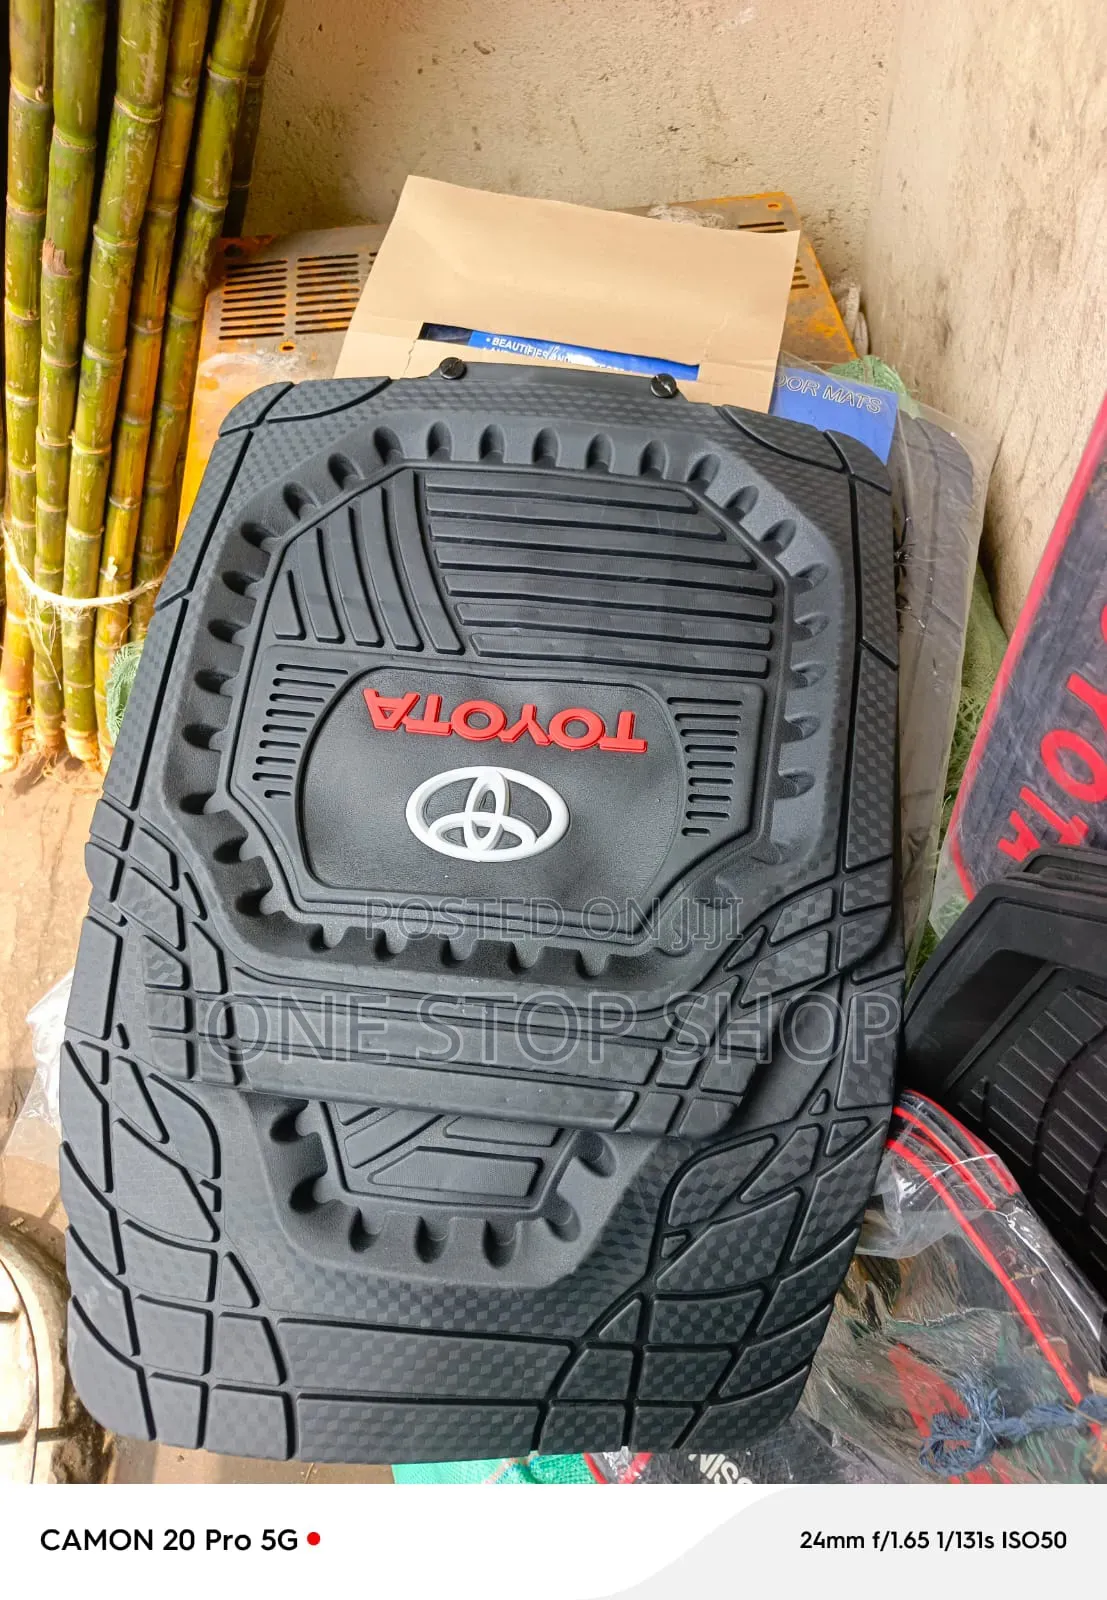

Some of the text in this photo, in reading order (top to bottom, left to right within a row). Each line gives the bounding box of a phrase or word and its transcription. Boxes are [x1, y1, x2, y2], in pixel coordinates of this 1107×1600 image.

[491, 337, 549, 360] BEAUTIFIES
[822, 384, 882, 414] MATS
[363, 688, 648, 753] TOYOTA
